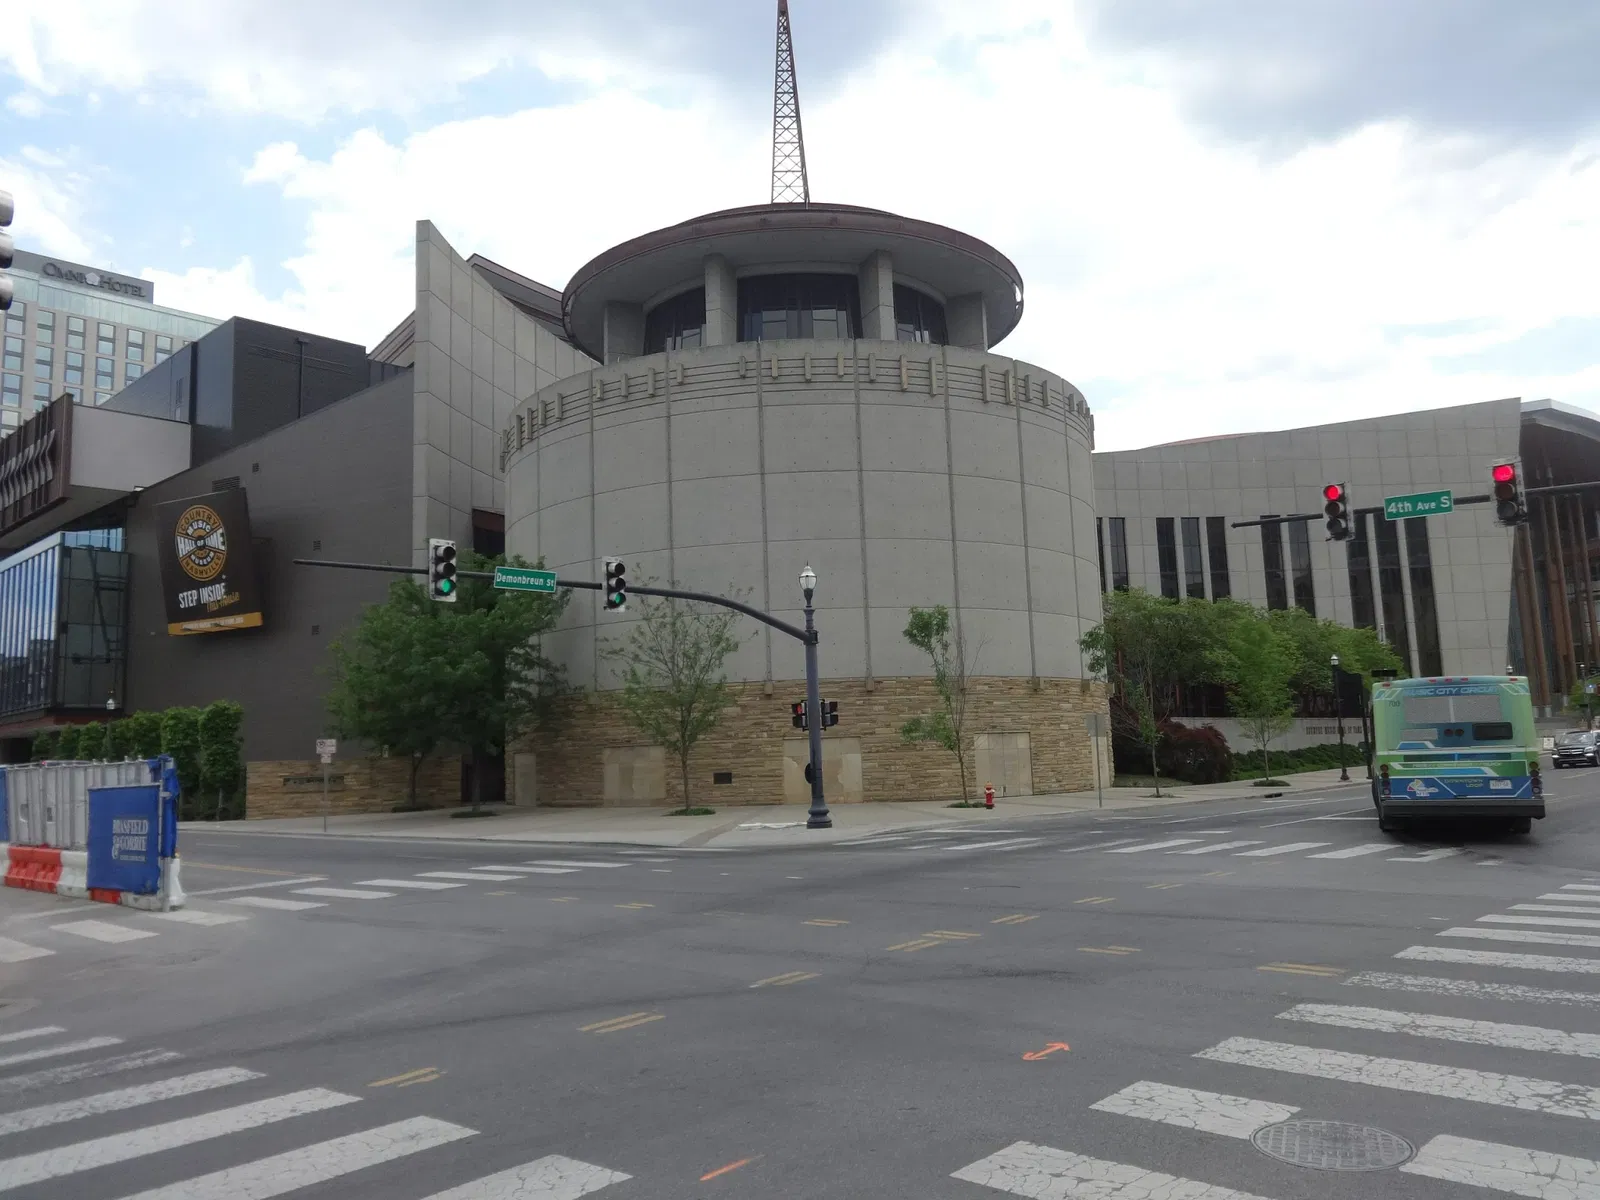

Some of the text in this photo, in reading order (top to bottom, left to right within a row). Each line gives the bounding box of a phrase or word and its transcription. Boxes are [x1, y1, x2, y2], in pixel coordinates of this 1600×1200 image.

[100, 275, 146, 298] HOTEL
[1388, 496, 1450, 513] 4th Ave S
[180, 510, 218, 532] COUNTRY
[187, 520, 212, 536] MUSIC
[184, 554, 222, 576] NASHVILLE
[496, 572, 554, 587] Demonbreun St
[178, 589, 198, 608] STEP
[1436, 687, 1458, 695] CITY
